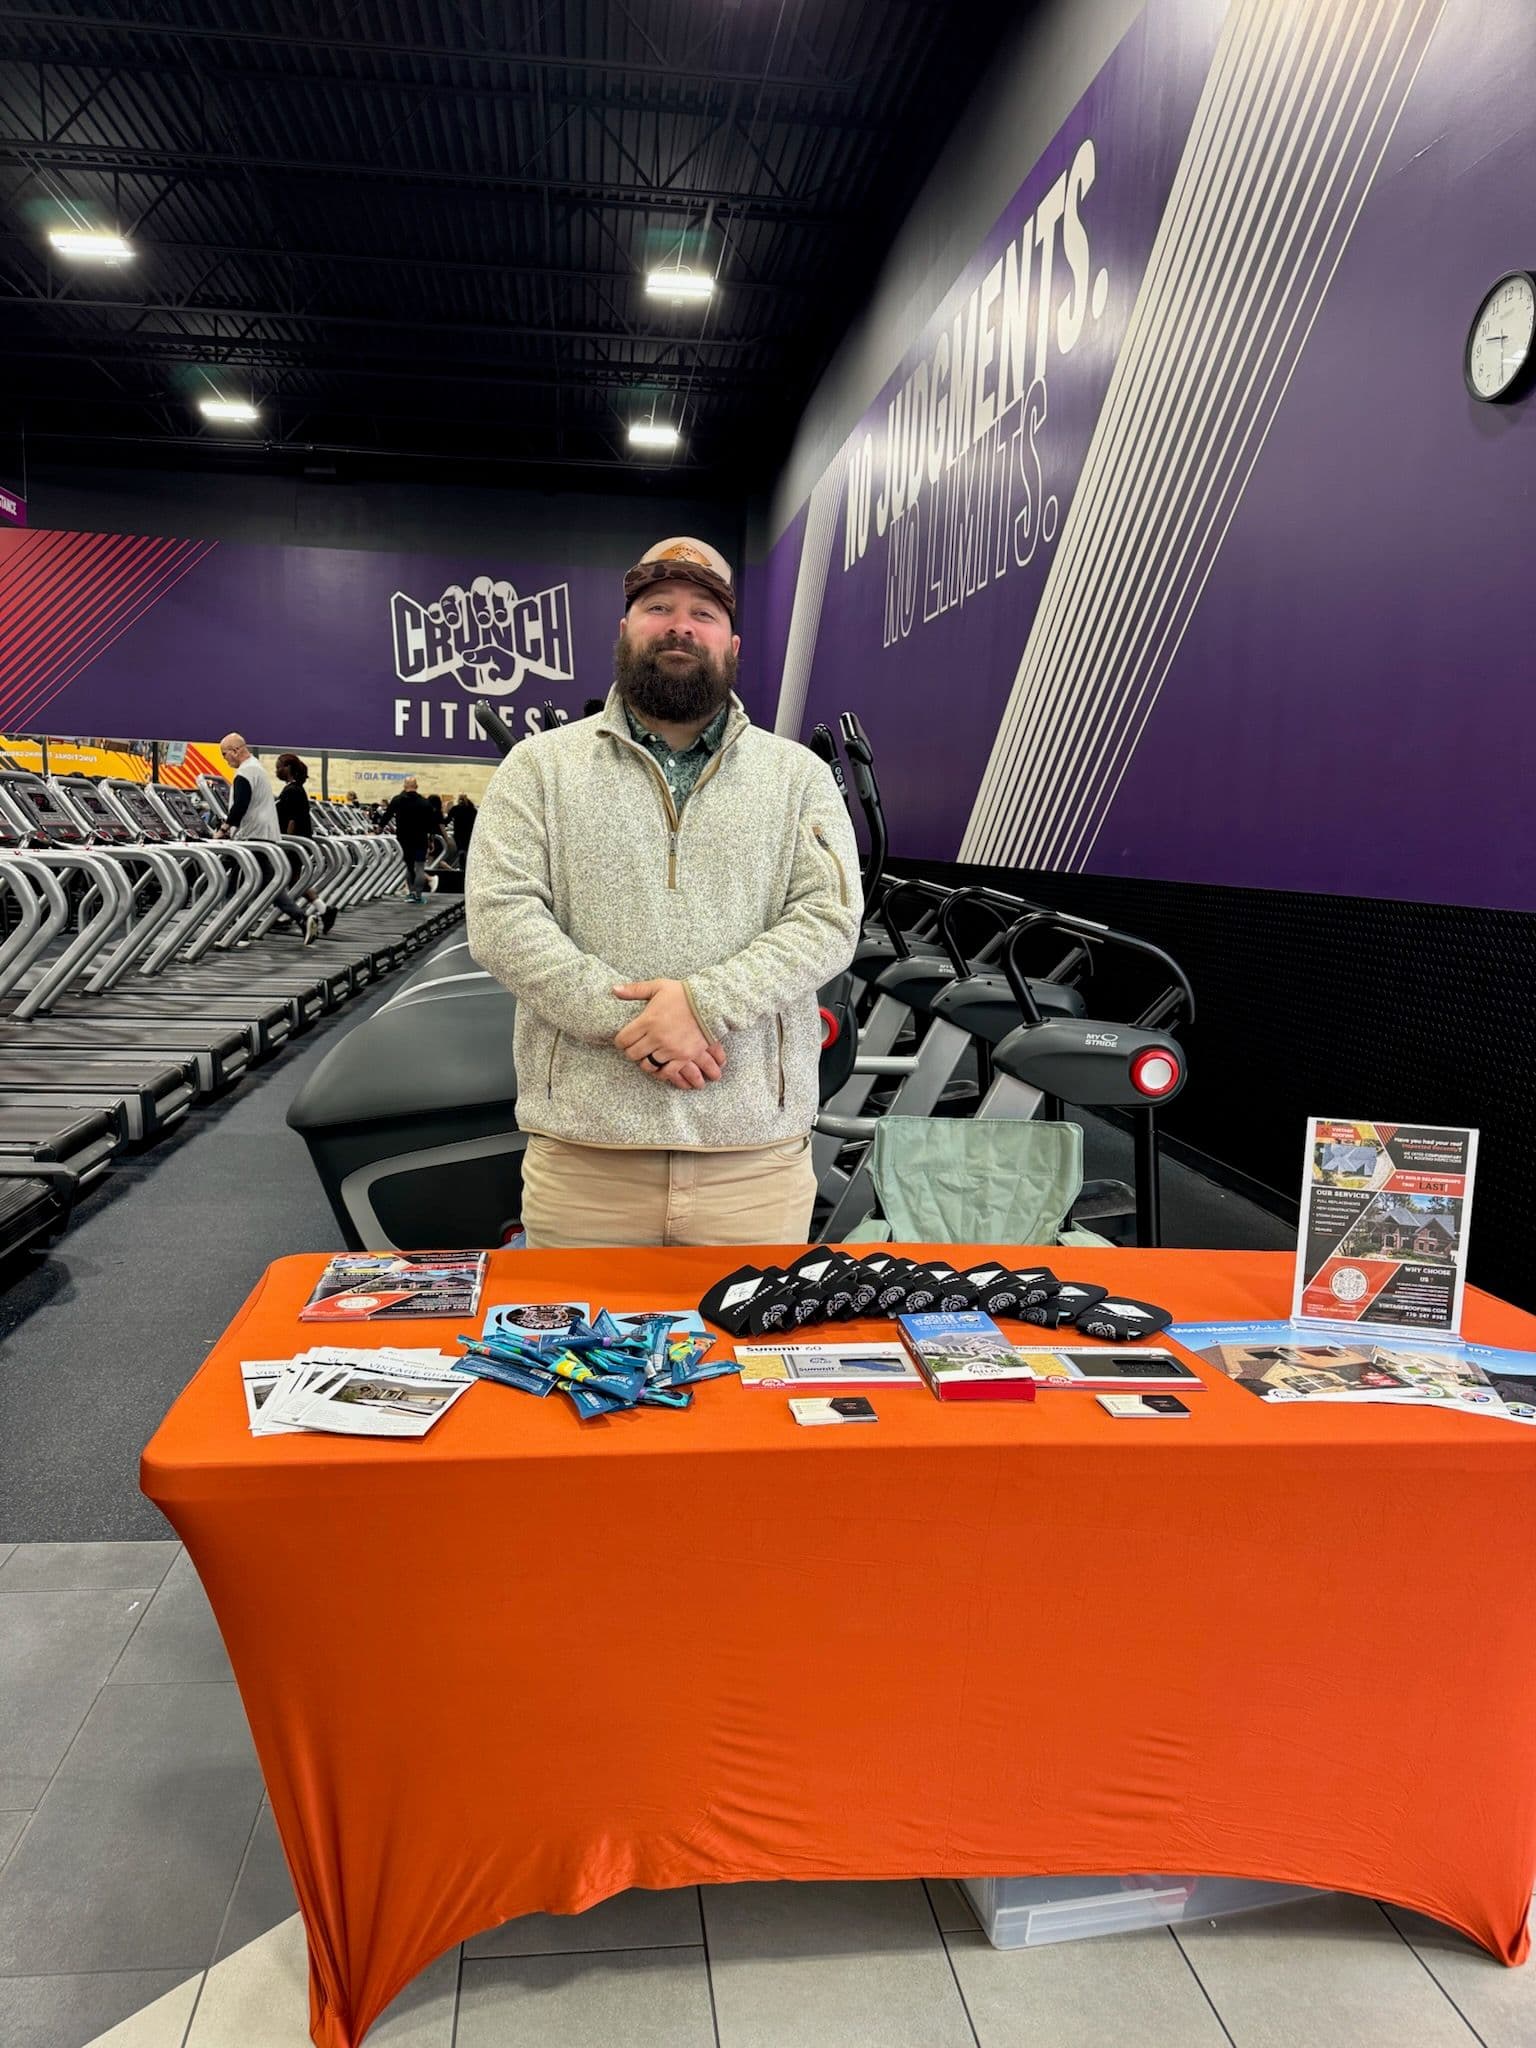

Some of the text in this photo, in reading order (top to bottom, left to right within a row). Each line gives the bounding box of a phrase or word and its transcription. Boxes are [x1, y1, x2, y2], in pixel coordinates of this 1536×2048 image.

[843, 138, 1108, 572] NO JUDGMENTS.
[883, 378, 1058, 648] NO LIMITS.
[391, 582, 575, 682] CRUNCH
[1085, 1039, 1118, 1048] STRIDE
[1334, 1191, 1370, 1199] SERVICES
[1423, 1268, 1451, 1276] CHOOSE
